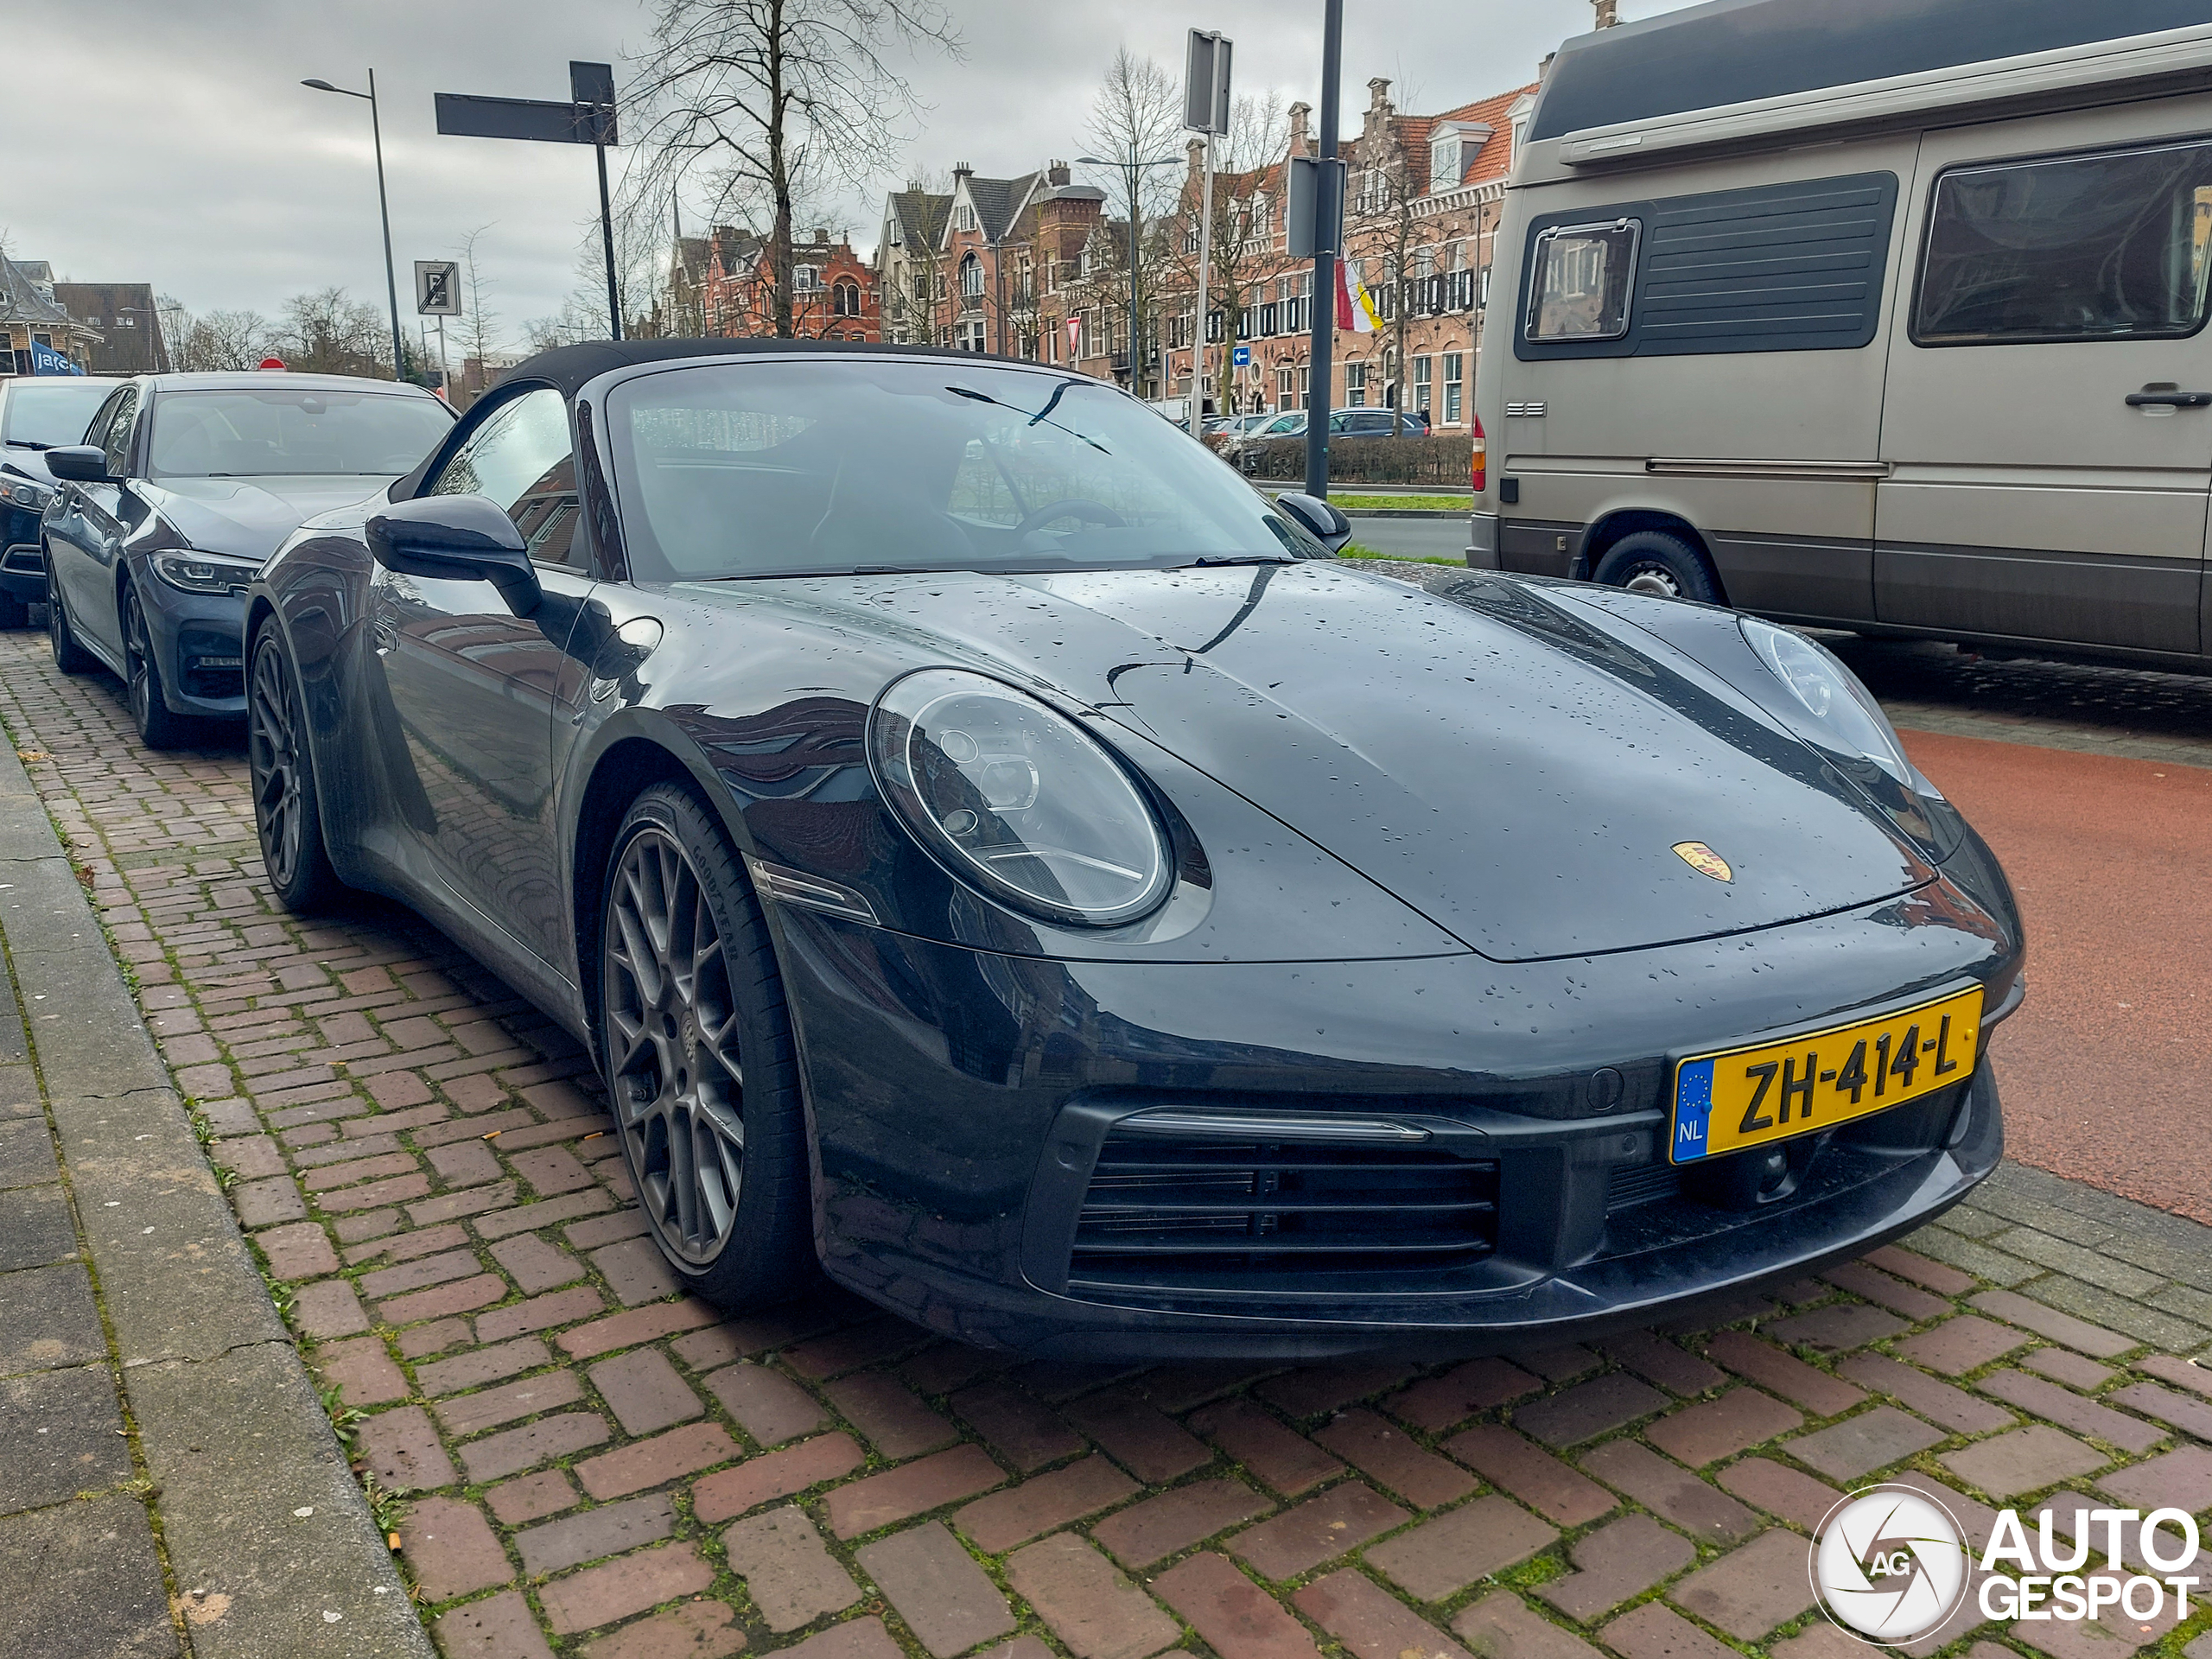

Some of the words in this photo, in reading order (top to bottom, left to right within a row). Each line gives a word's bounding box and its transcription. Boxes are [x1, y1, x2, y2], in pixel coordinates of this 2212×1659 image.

[693, 845, 739, 962] GOODYEAR
[1679, 1120, 1703, 1143] NL
[1738, 1013, 1957, 1133] ZH-414-L
